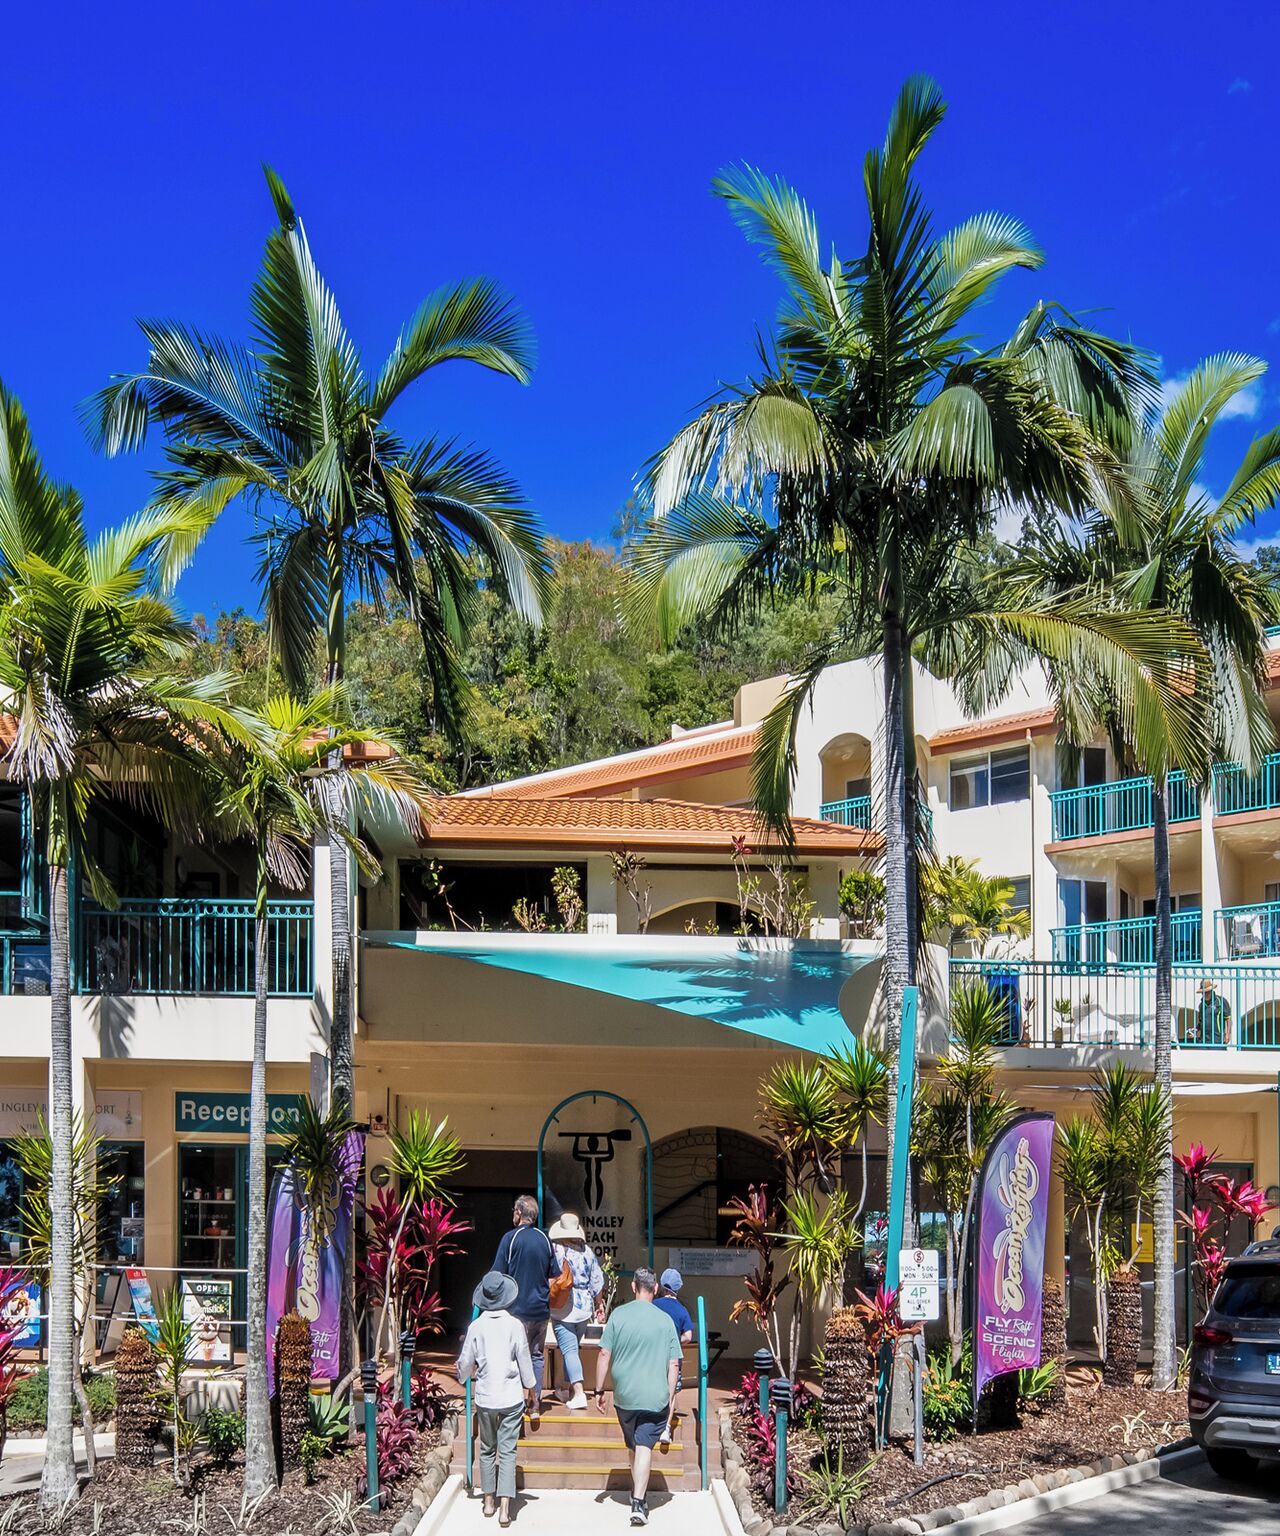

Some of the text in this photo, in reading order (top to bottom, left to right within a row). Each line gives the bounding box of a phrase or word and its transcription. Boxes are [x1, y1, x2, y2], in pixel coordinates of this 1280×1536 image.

[96, 1104, 117, 1114] ORT
[181, 1100, 301, 1126] Recepion
[583, 1216, 624, 1228] INGLEY
[585, 1232, 616, 1243] EACH
[594, 1246, 619, 1258] ORT
[911, 1287, 927, 1297] 4P
[985, 1316, 1011, 1328] FLY
[983, 1333, 1036, 1348] SCENIC
[990, 1343, 1025, 1364] Flights
